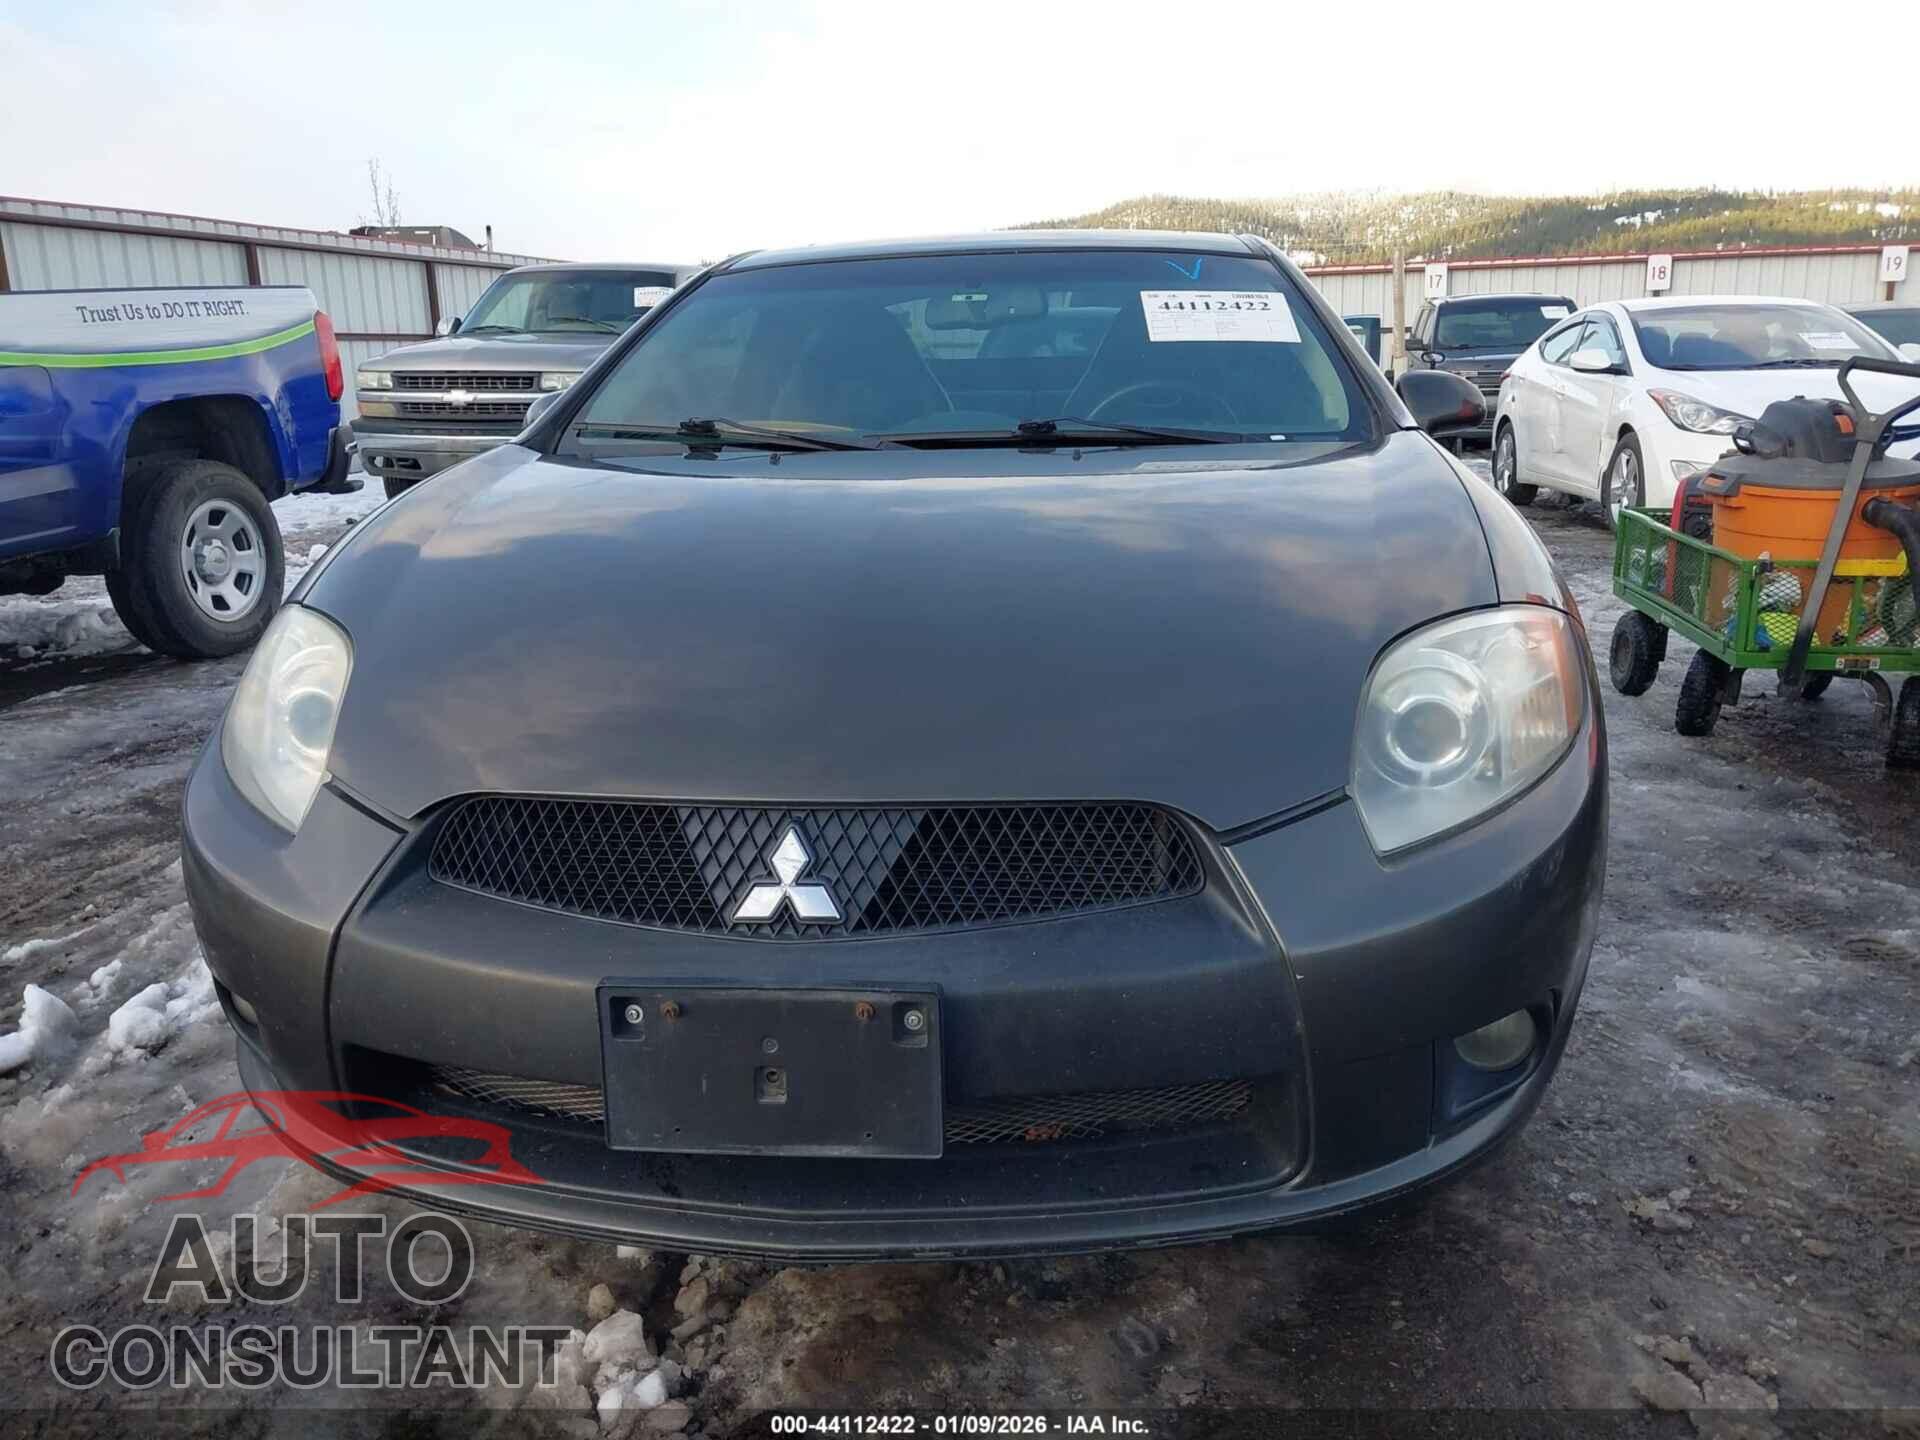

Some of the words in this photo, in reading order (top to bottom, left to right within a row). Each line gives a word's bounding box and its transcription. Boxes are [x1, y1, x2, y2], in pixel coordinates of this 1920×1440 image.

[1887, 256, 1903, 272] 19
[1652, 265, 1666, 281] 18
[1430, 274, 1442, 289] 17
[76, 305, 122, 323] Trust
[122, 304, 145, 320] Us
[145, 304, 161, 319] to
[162, 302, 185, 318] DO
[185, 301, 202, 317] IT
[203, 300, 249, 317] RIGHT.
[1158, 301, 1272, 311] 44112422
